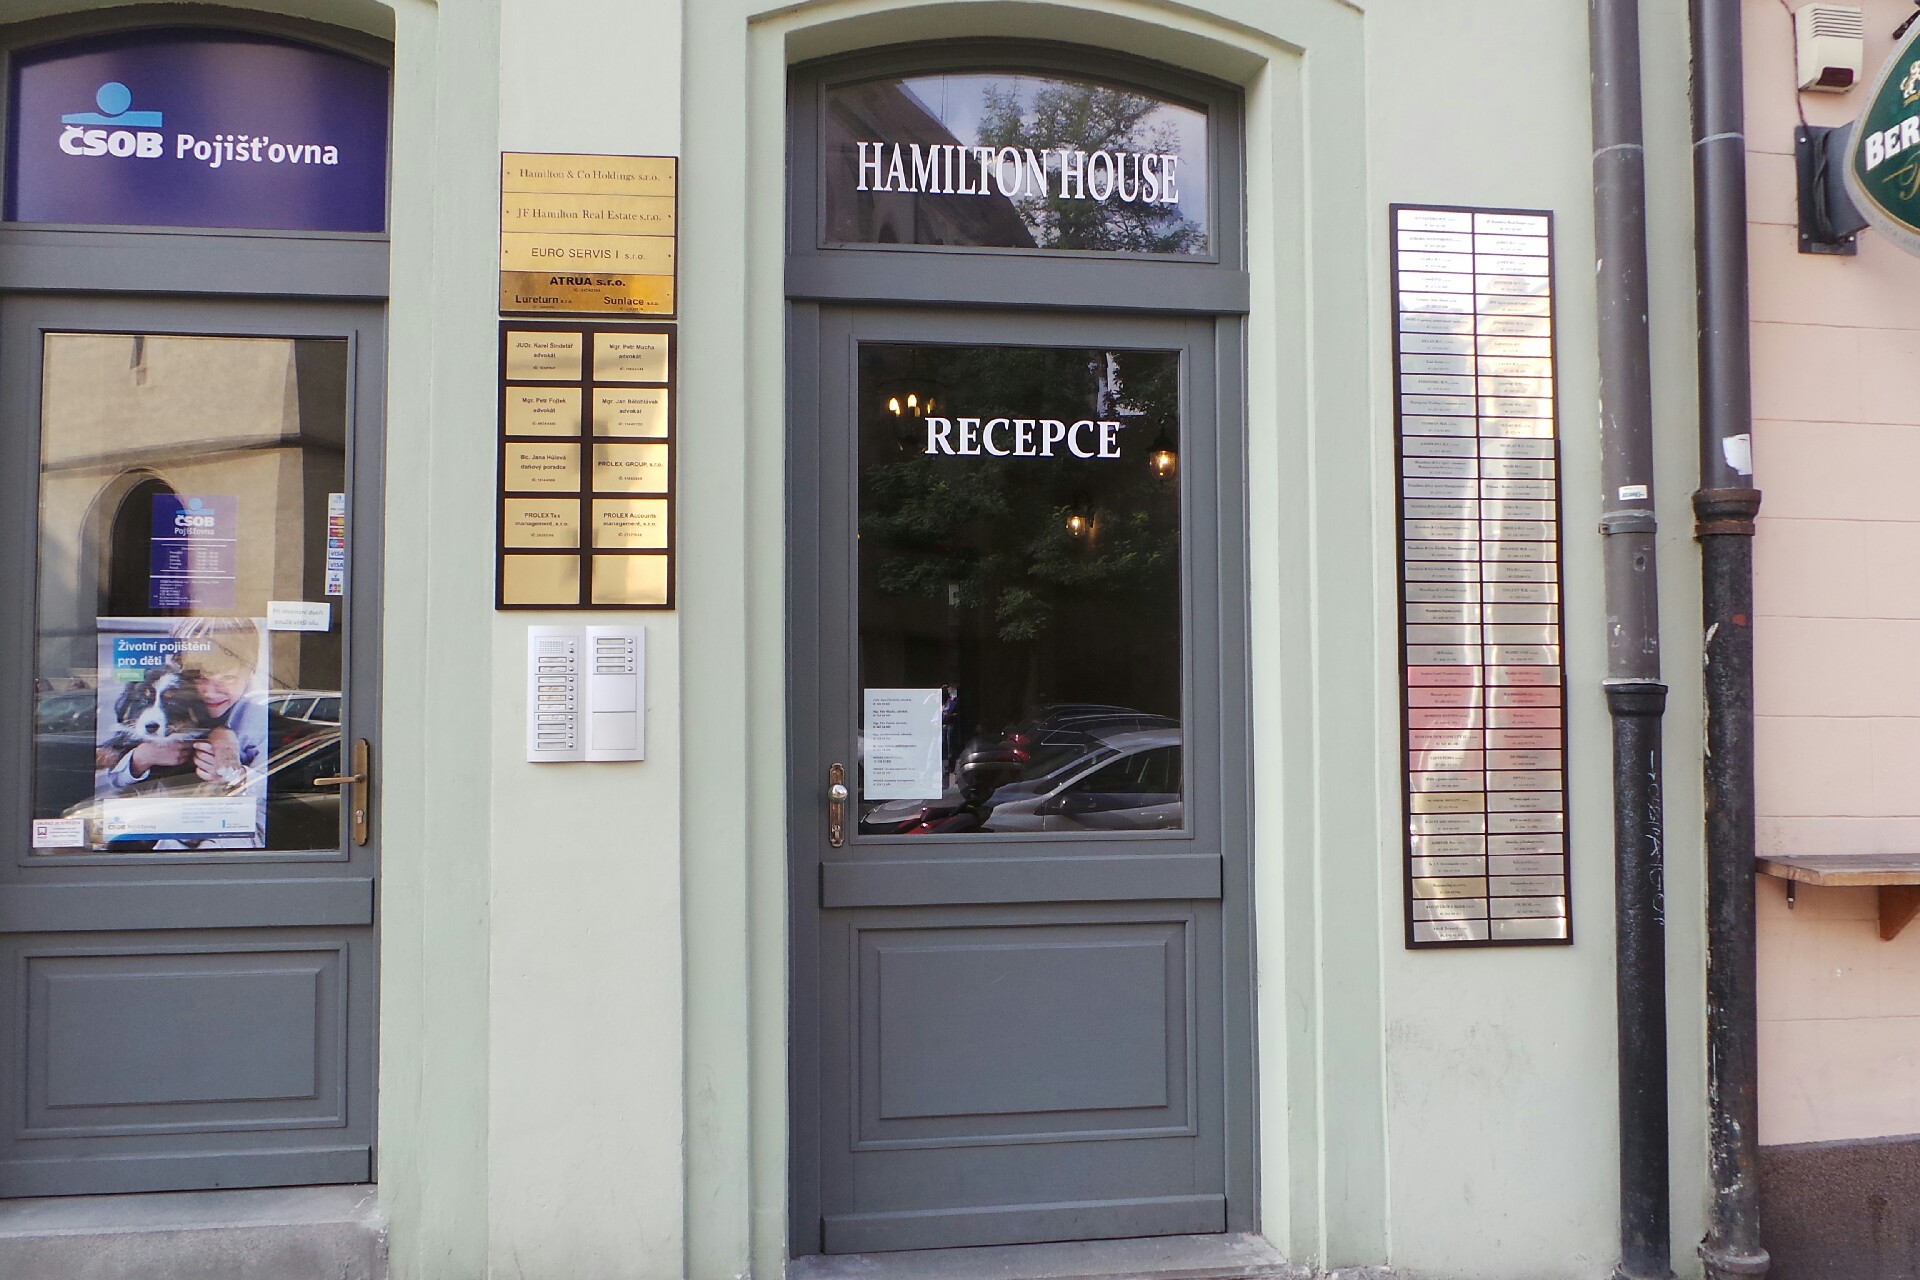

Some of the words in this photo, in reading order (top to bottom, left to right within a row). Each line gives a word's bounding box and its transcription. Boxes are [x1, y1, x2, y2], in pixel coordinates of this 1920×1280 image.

[60, 126, 164, 158] ČSOB
[176, 134, 338, 168] Pojišťovna
[520, 169, 564, 178] Hamilton
[566, 170, 574, 178] &
[577, 170, 590, 179] Co
[593, 170, 635, 181] Holdings
[856, 142, 1049, 198] HAMILTON
[1058, 149, 1179, 204] HOUSE
[516, 208, 530, 218] JF
[532, 209, 578, 219] Hamilton
[582, 210, 604, 220] Real
[608, 211, 638, 220] Estate
[532, 248, 564, 258] EURO
[568, 249, 612, 259] SERVIS
[550, 276, 592, 286] ATRUA
[596, 278, 626, 287] s.r.o.
[515, 295, 559, 304] Lureturn
[604, 296, 644, 305] Sunlace
[924, 417, 1121, 459] RECEPCE
[175, 514, 215, 527] ČSOB
[174, 527, 215, 536] Pojišťovna
[118, 640, 157, 652] Životní
[160, 641, 211, 653] pojištění
[118, 657, 137, 667] pro
[140, 656, 162, 666] děti
